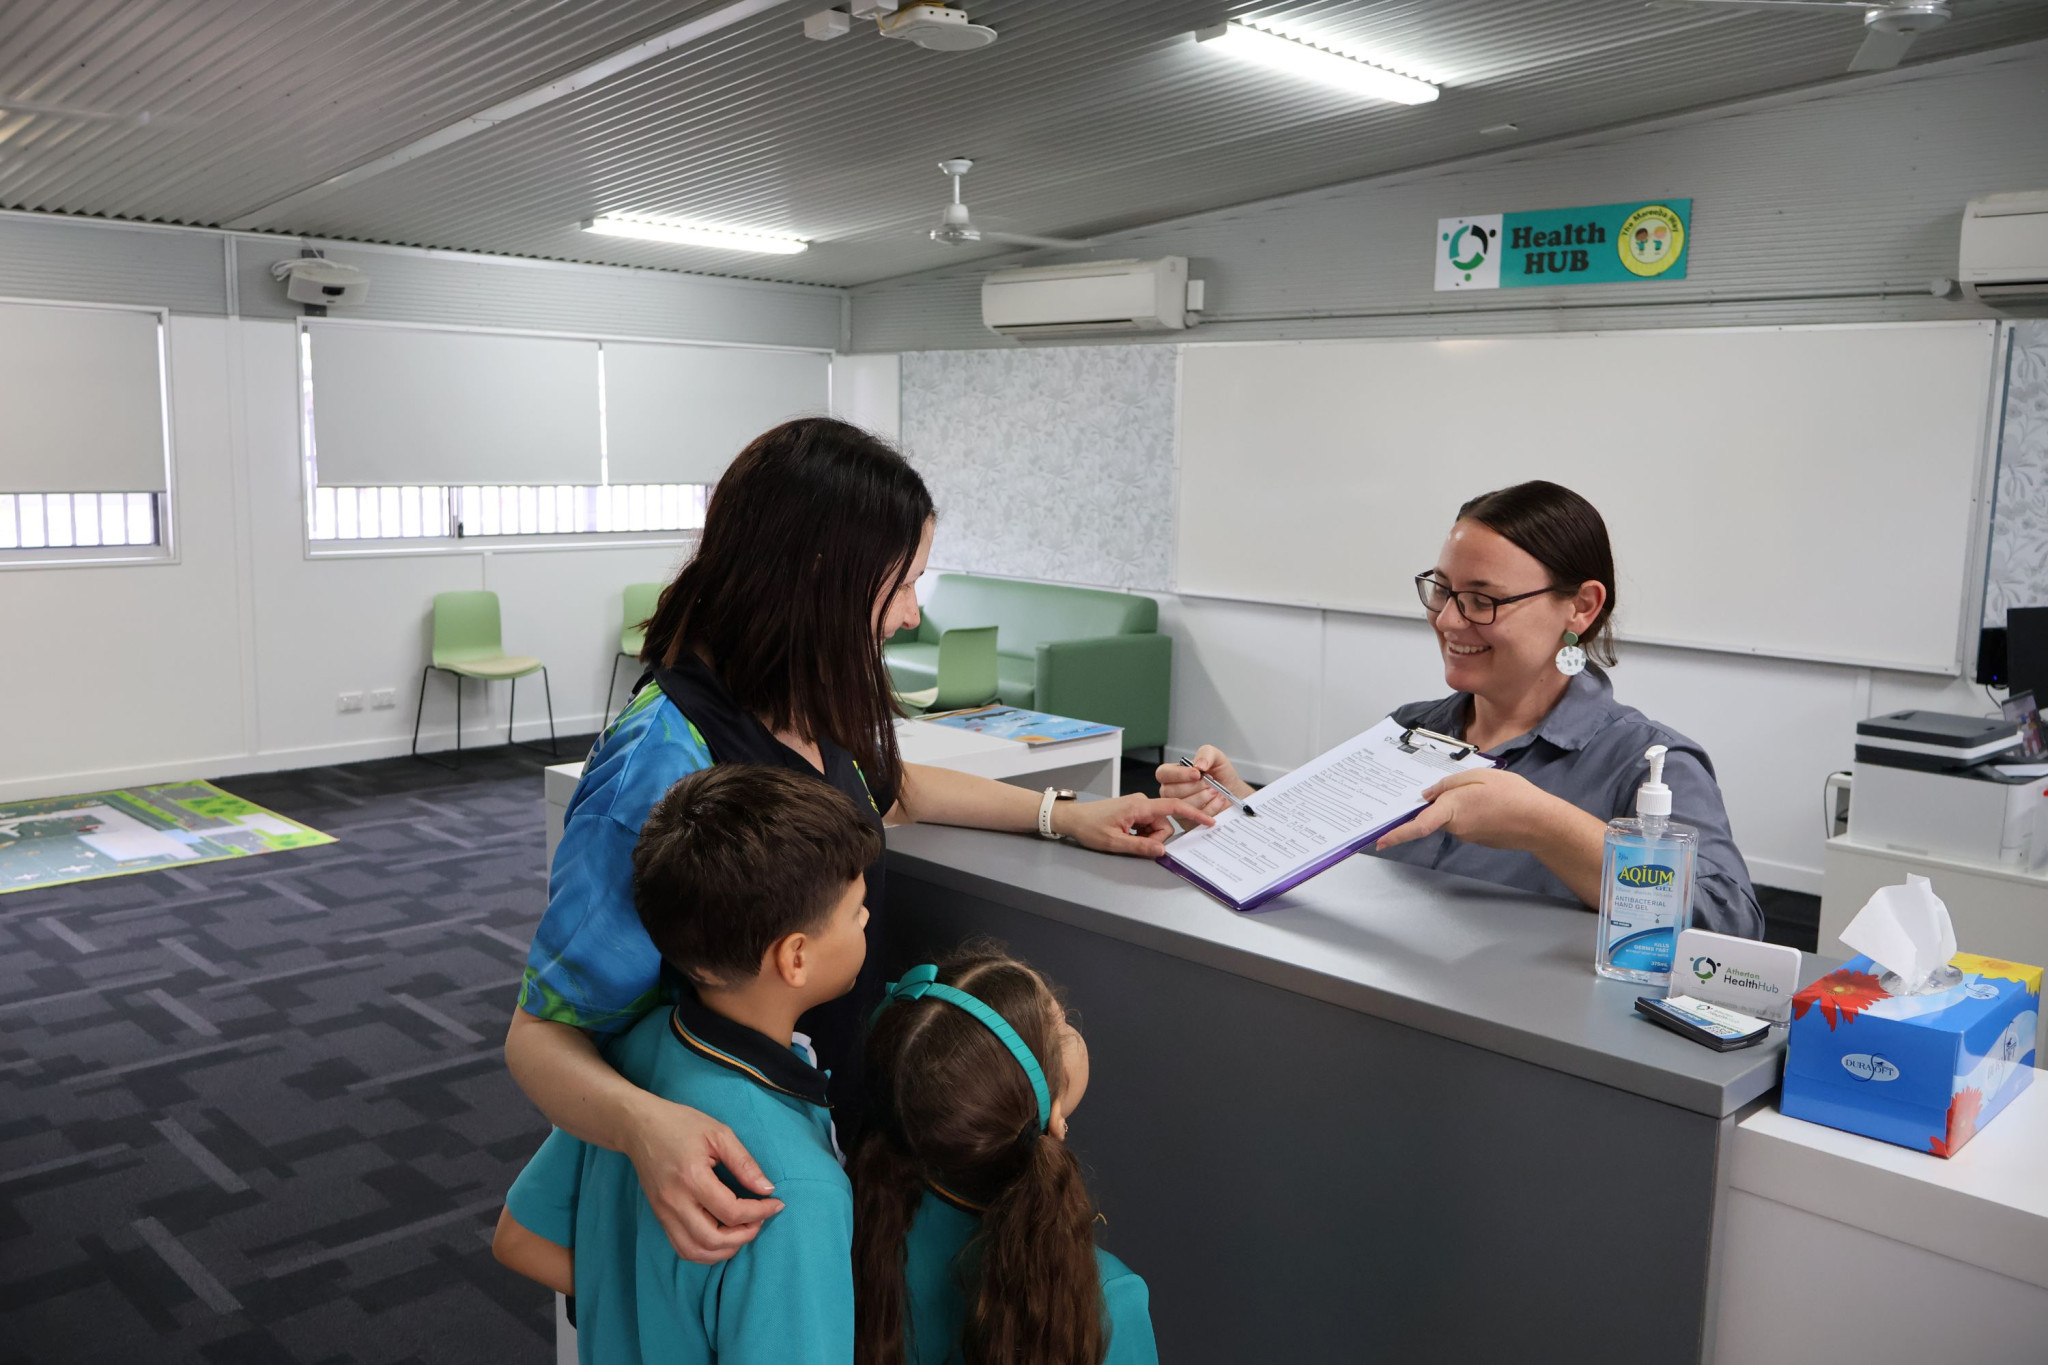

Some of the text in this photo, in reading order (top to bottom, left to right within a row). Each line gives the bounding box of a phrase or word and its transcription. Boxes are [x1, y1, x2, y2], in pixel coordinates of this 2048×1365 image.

[1633, 209, 1668, 222] Mareeba
[1511, 222, 1606, 249] Health
[1524, 250, 1589, 274] HUB
[1615, 895, 1666, 907] ANTIBACTERIAL
[1615, 901, 1633, 909] HAND
[1725, 967, 1760, 980] Atherton
